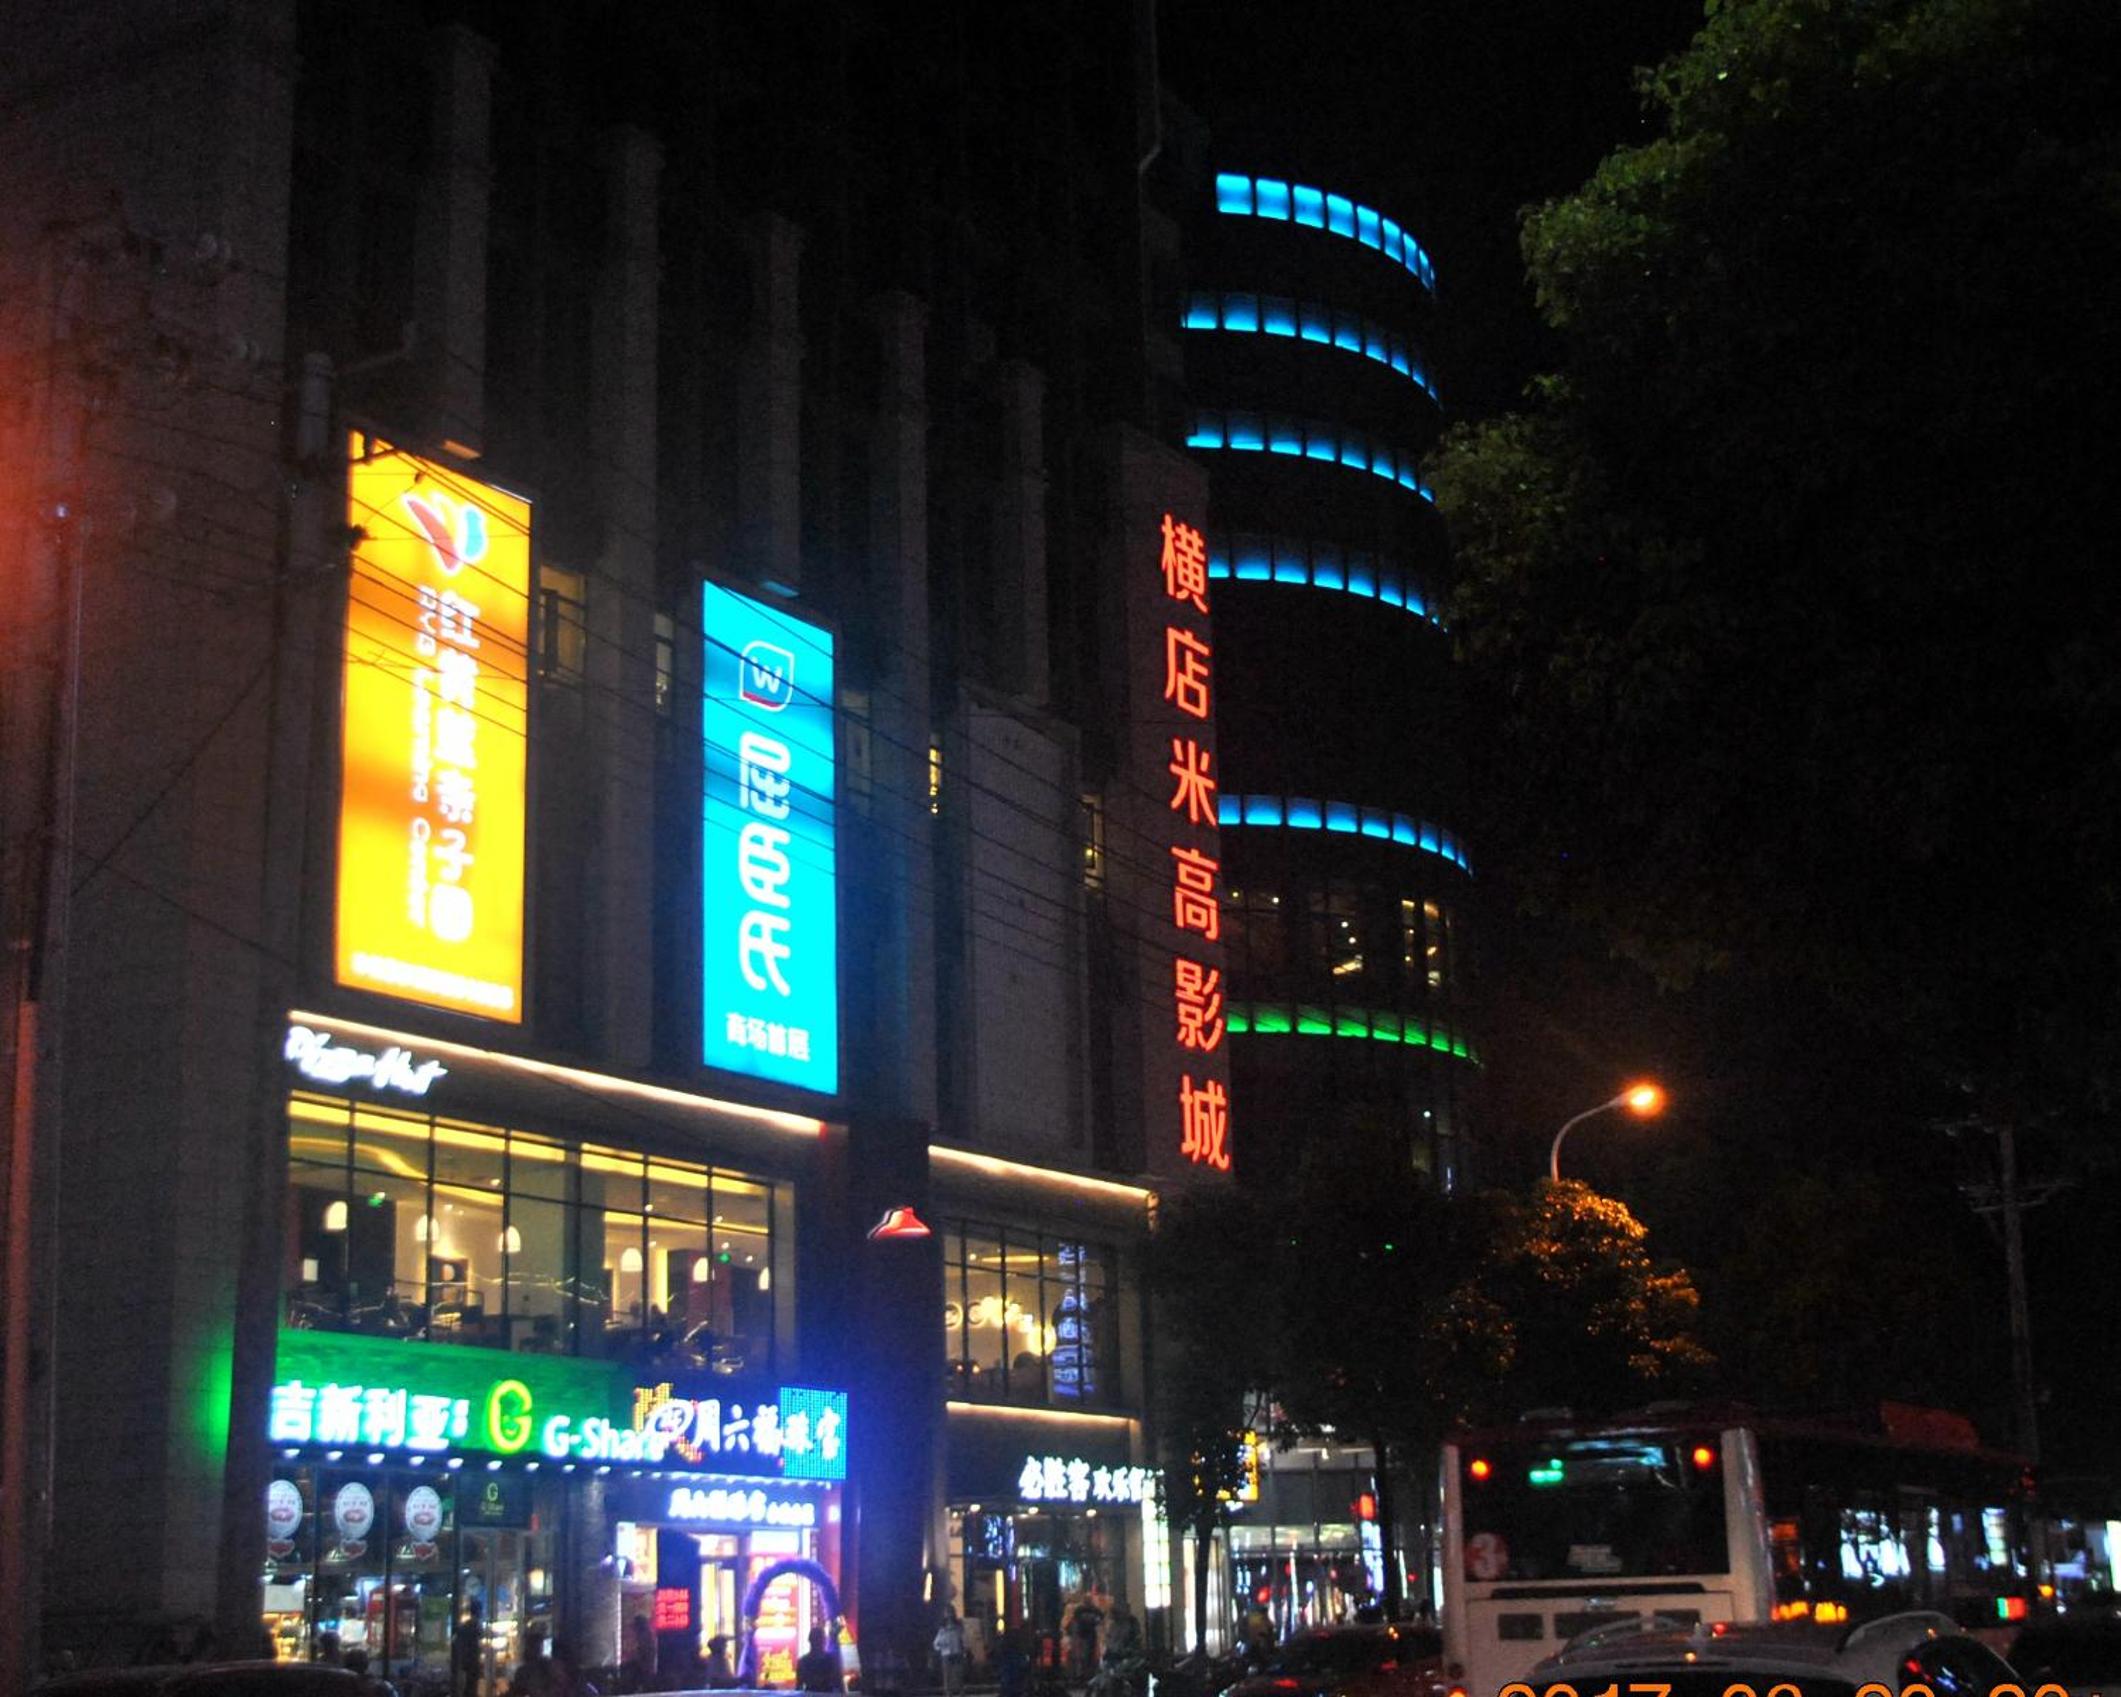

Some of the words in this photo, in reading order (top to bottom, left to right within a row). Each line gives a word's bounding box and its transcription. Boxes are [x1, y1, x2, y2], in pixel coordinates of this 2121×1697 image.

[1160, 513, 1229, 1172] 横店米高影城
